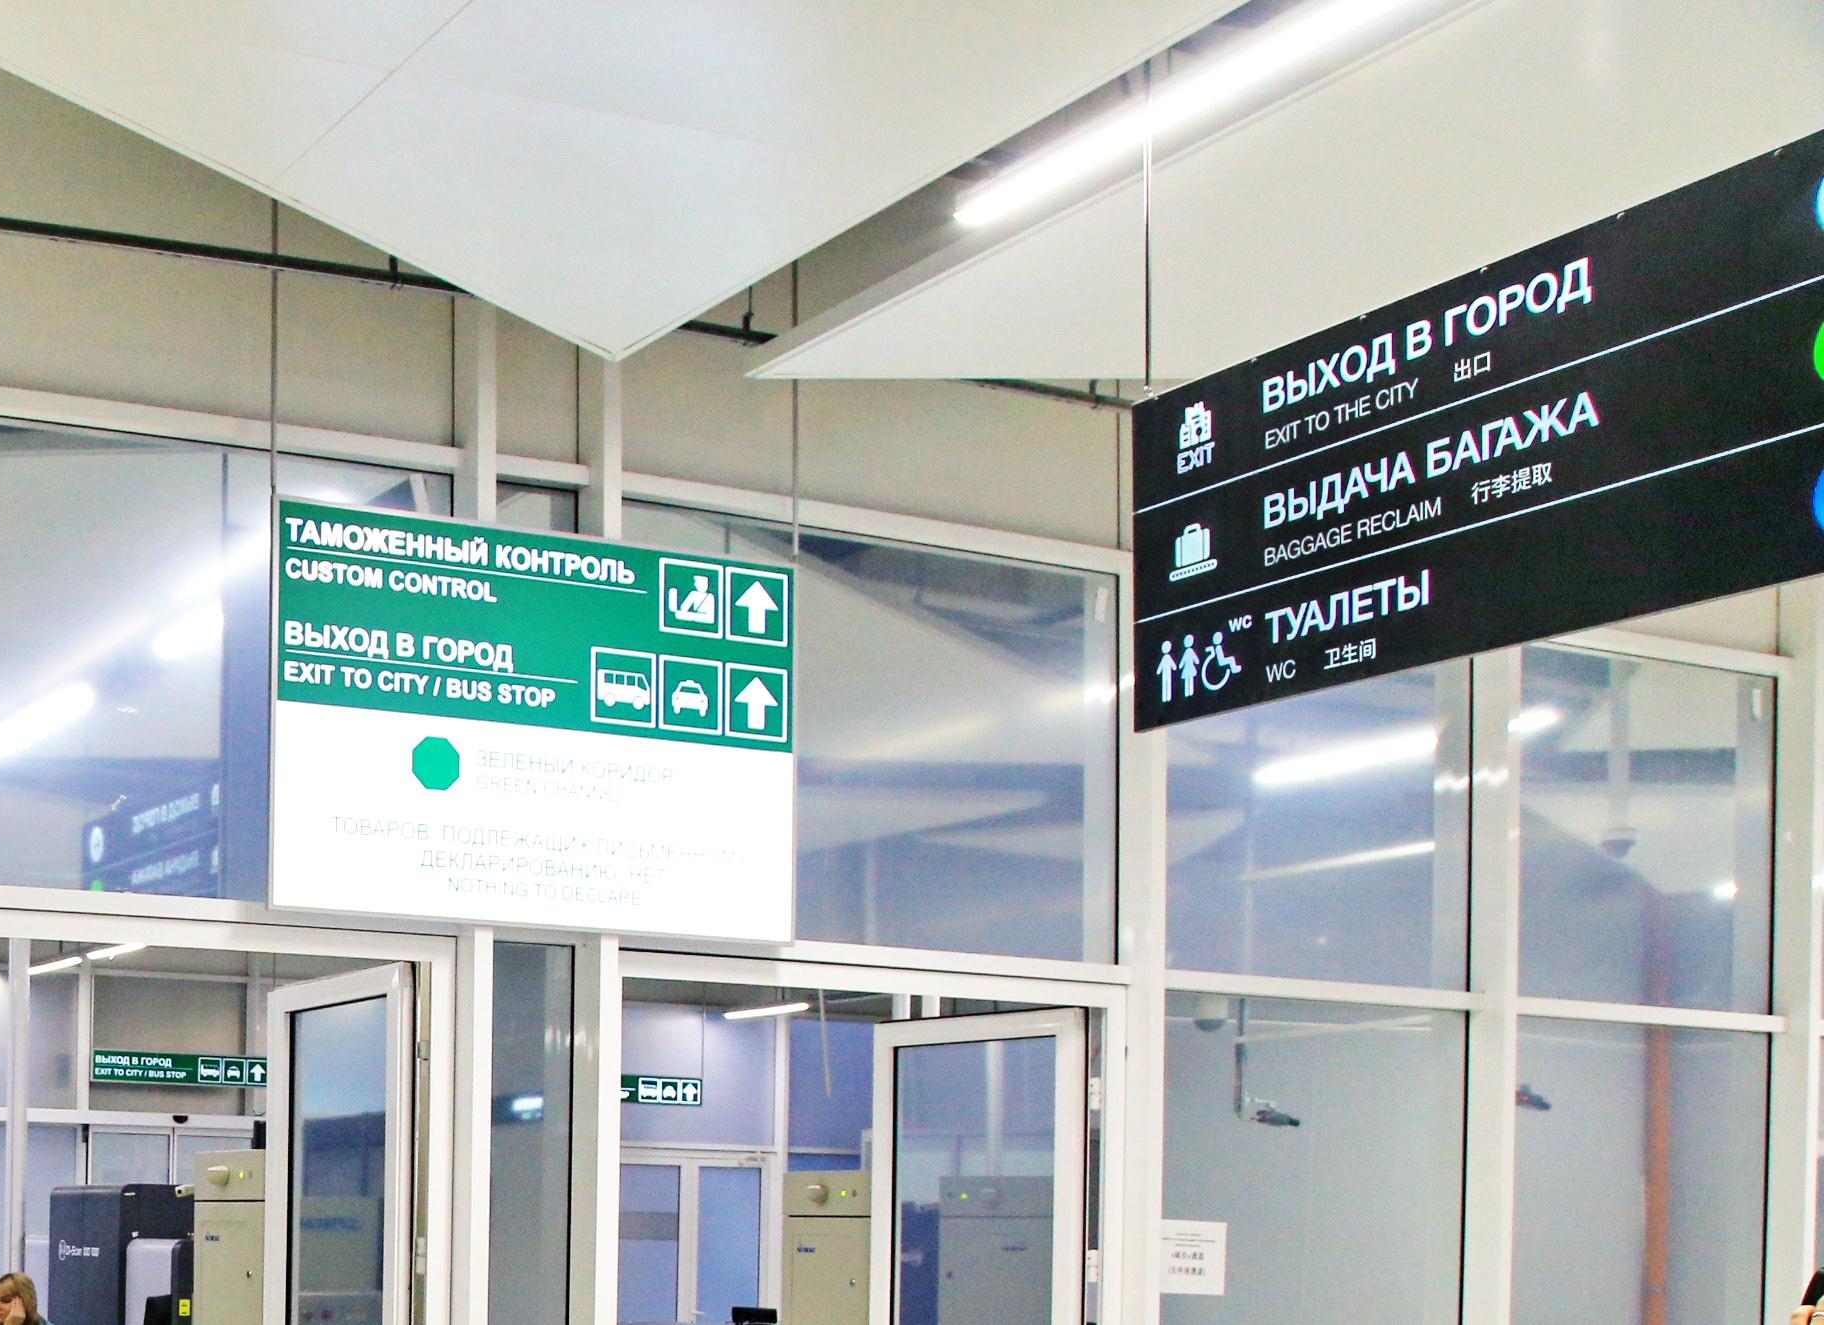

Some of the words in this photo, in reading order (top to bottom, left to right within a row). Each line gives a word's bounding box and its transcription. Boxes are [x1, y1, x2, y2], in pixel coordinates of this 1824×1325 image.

[1263, 333, 1395, 413] ВЫХОД
[1407, 320, 1432, 360] В
[1445, 258, 1592, 346] ГОРОД
[1454, 352, 1490, 382] 出口
[1266, 420, 1301, 449] EXIT
[1304, 411, 1329, 434] TO
[1334, 395, 1370, 424] THE
[1376, 378, 1418, 410] CITY
[1177, 442, 1215, 474] EXIT
[1264, 452, 1415, 528] ВЫДАЧА
[1427, 392, 1599, 478] БАГАЖА
[1472, 462, 1552, 504] 行李提取
[286, 518, 488, 566] ТАМОЖЕННЫЙ
[496, 545, 635, 584] КОНТРОЛЬ
[1264, 524, 1352, 566] BAGGAGE
[1358, 497, 1441, 538] RECLAIM
[286, 558, 382, 588] CUSTOM
[389, 570, 497, 602] CONTROL
[1229, 615, 1252, 631] WC
[1265, 569, 1429, 643] ТУАЛЕТЫ
[285, 621, 388, 658] ВЫХОД
[396, 633, 414, 657] В
[423, 636, 513, 671] ГОРОД
[1324, 638, 1376, 669] 卫生间
[284, 661, 335, 685] EXIT
[340, 667, 372, 688] TO
[378, 671, 429, 694] CITY
[433, 677, 441, 696] /
[446, 678, 492, 702] BUS
[498, 684, 555, 707] STOP
[1266, 660, 1296, 682] WC
[95, 1055, 130, 1065] ВЫХОД
[141, 1057, 172, 1067] ГОРОД
[95, 1067, 112, 1076] EXIT
[114, 1068, 124, 1076] TO
[149, 1070, 164, 1078] BUS
